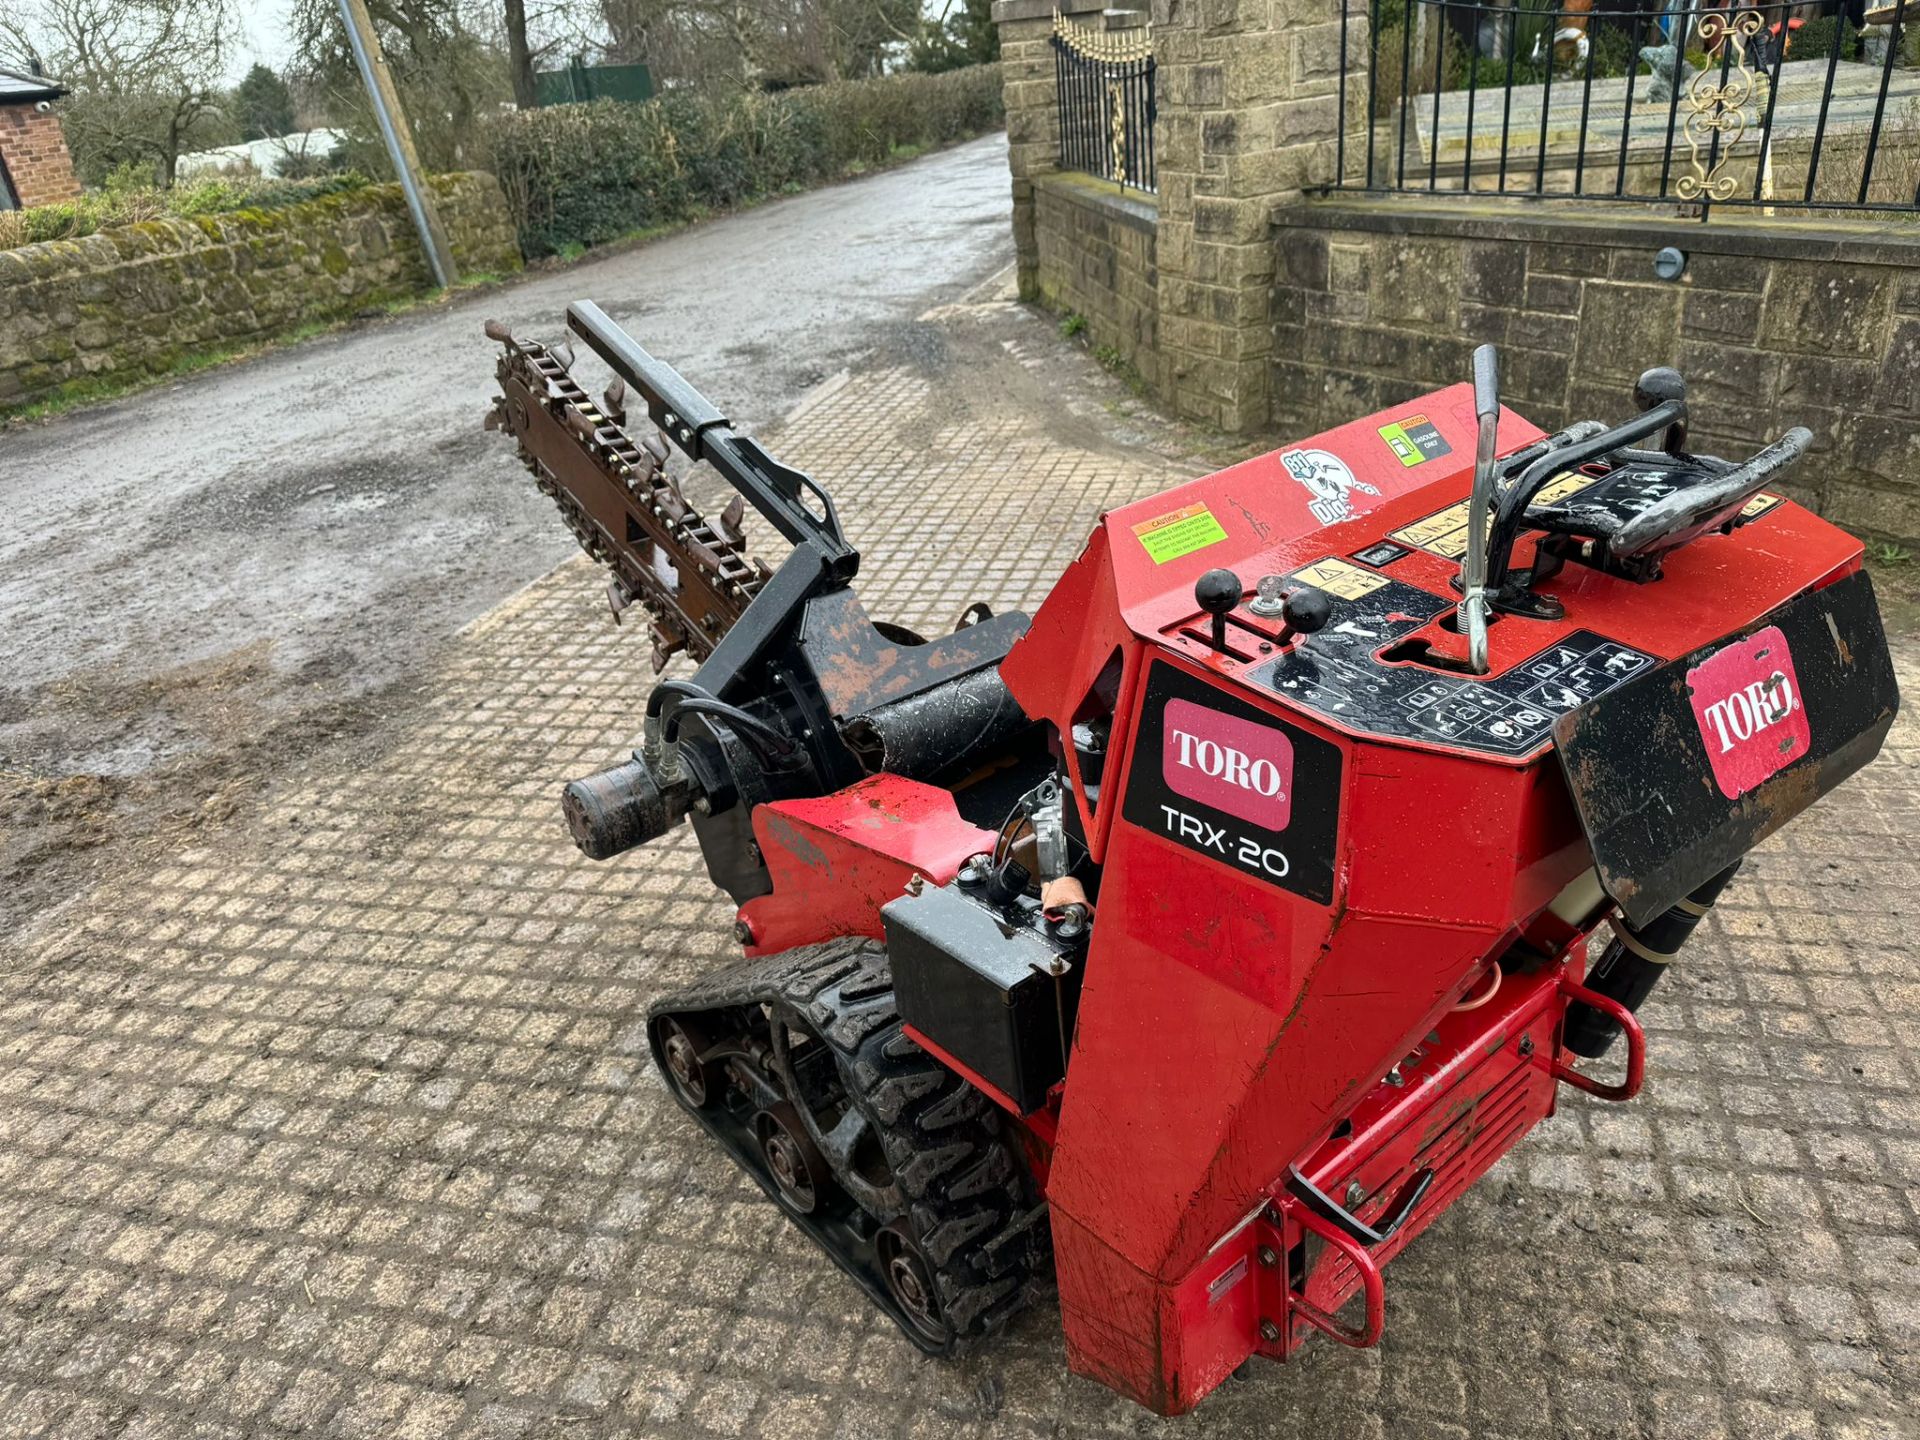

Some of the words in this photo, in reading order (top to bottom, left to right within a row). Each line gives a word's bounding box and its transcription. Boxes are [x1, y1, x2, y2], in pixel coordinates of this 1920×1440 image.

[1283, 452, 1311, 473] 811
[1151, 514, 1180, 528] CAUTION
[1704, 670, 1793, 753] TORO
[1173, 729, 1281, 796] TORO
